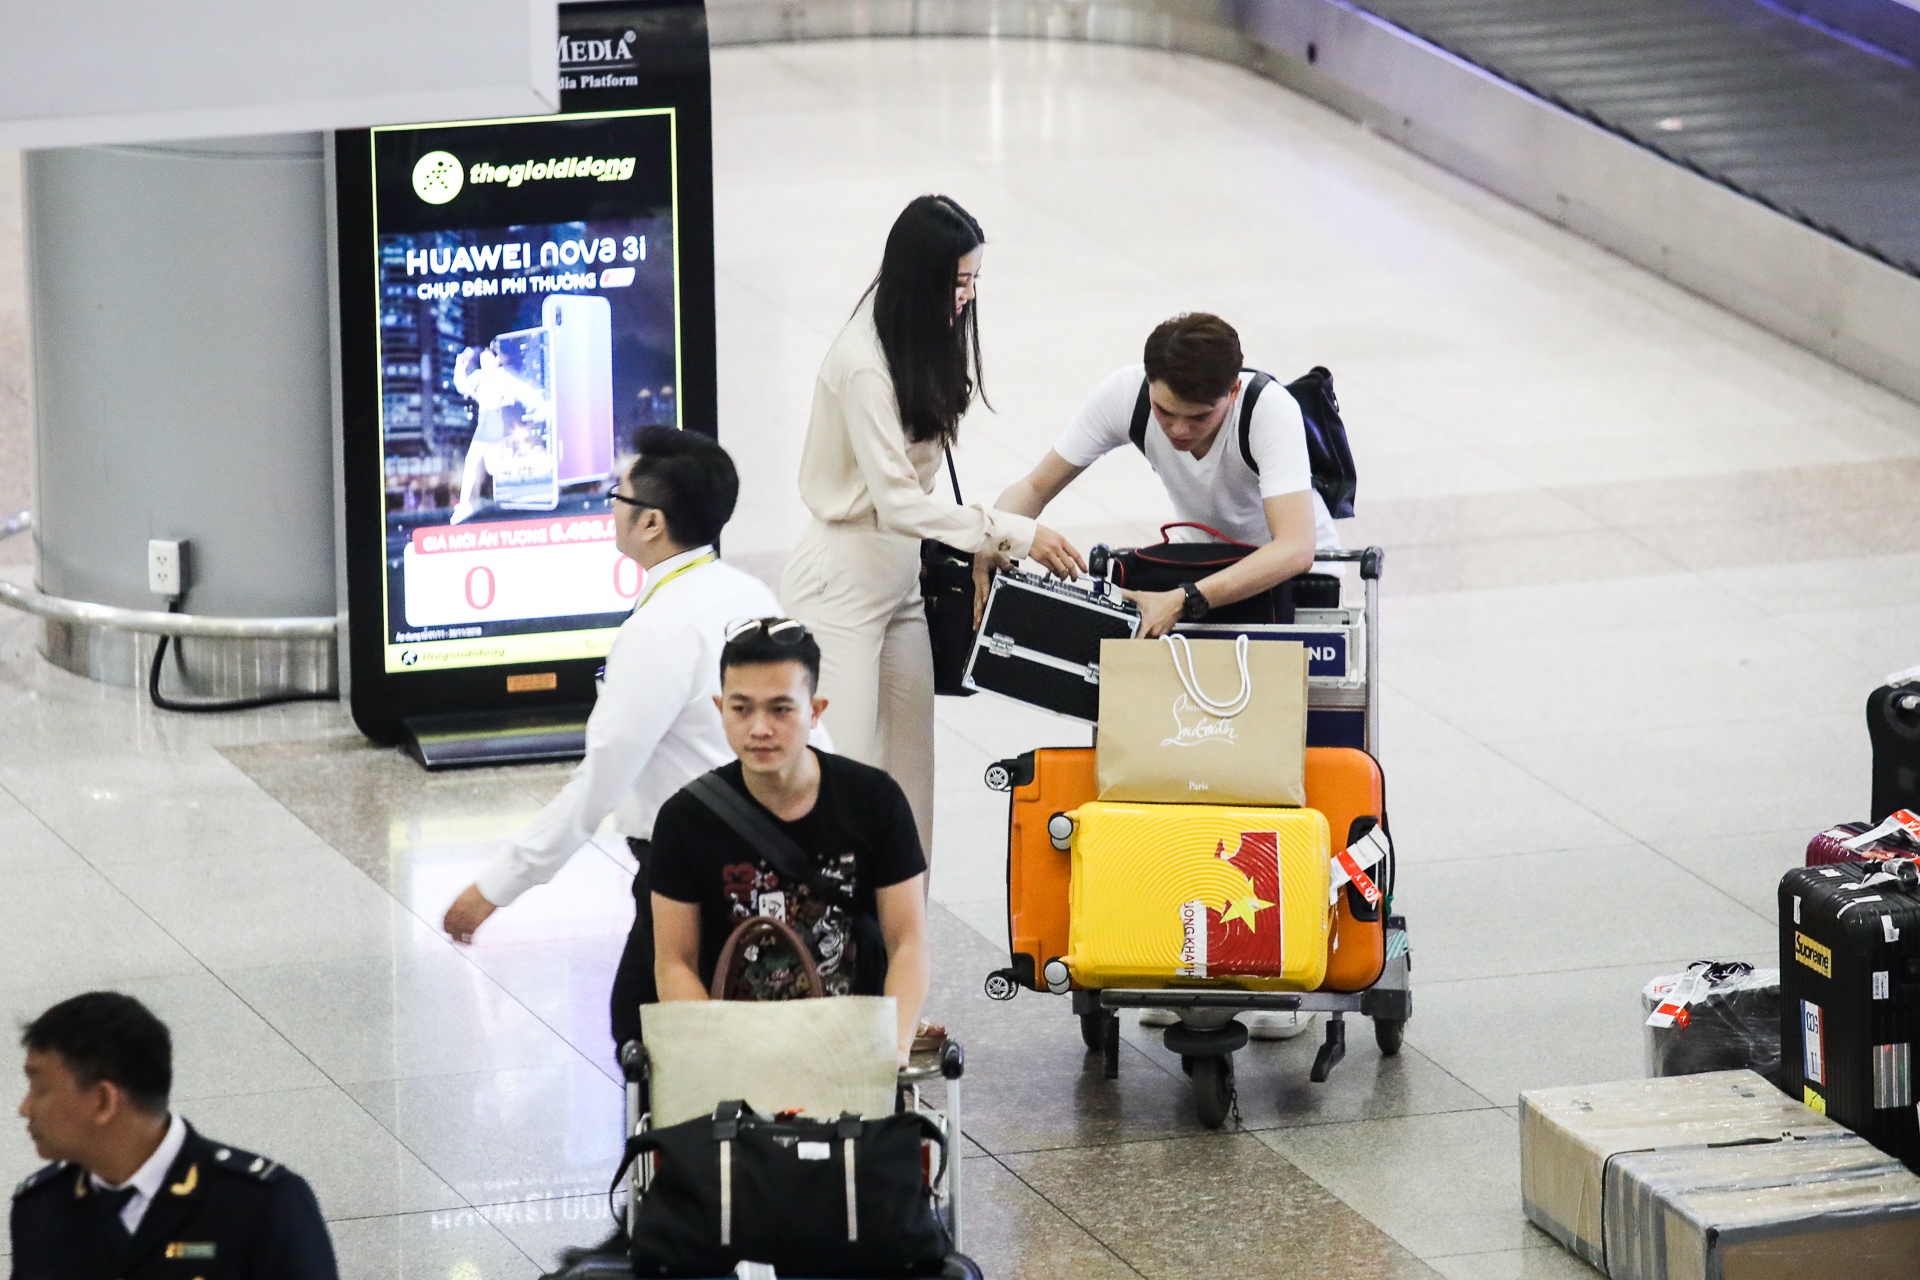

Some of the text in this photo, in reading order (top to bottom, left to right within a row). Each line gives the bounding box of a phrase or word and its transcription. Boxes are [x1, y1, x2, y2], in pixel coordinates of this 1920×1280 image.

[580, 73, 638, 89] Platform
[406, 242, 531, 276] HUAWEI
[622, 235, 647, 262] 3i
[501, 277, 527, 295] PHI
[464, 565, 496, 610] 0
[613, 553, 643, 598] 0
[1189, 781, 1209, 790] Paris
[1796, 934, 1829, 969] Supreme
